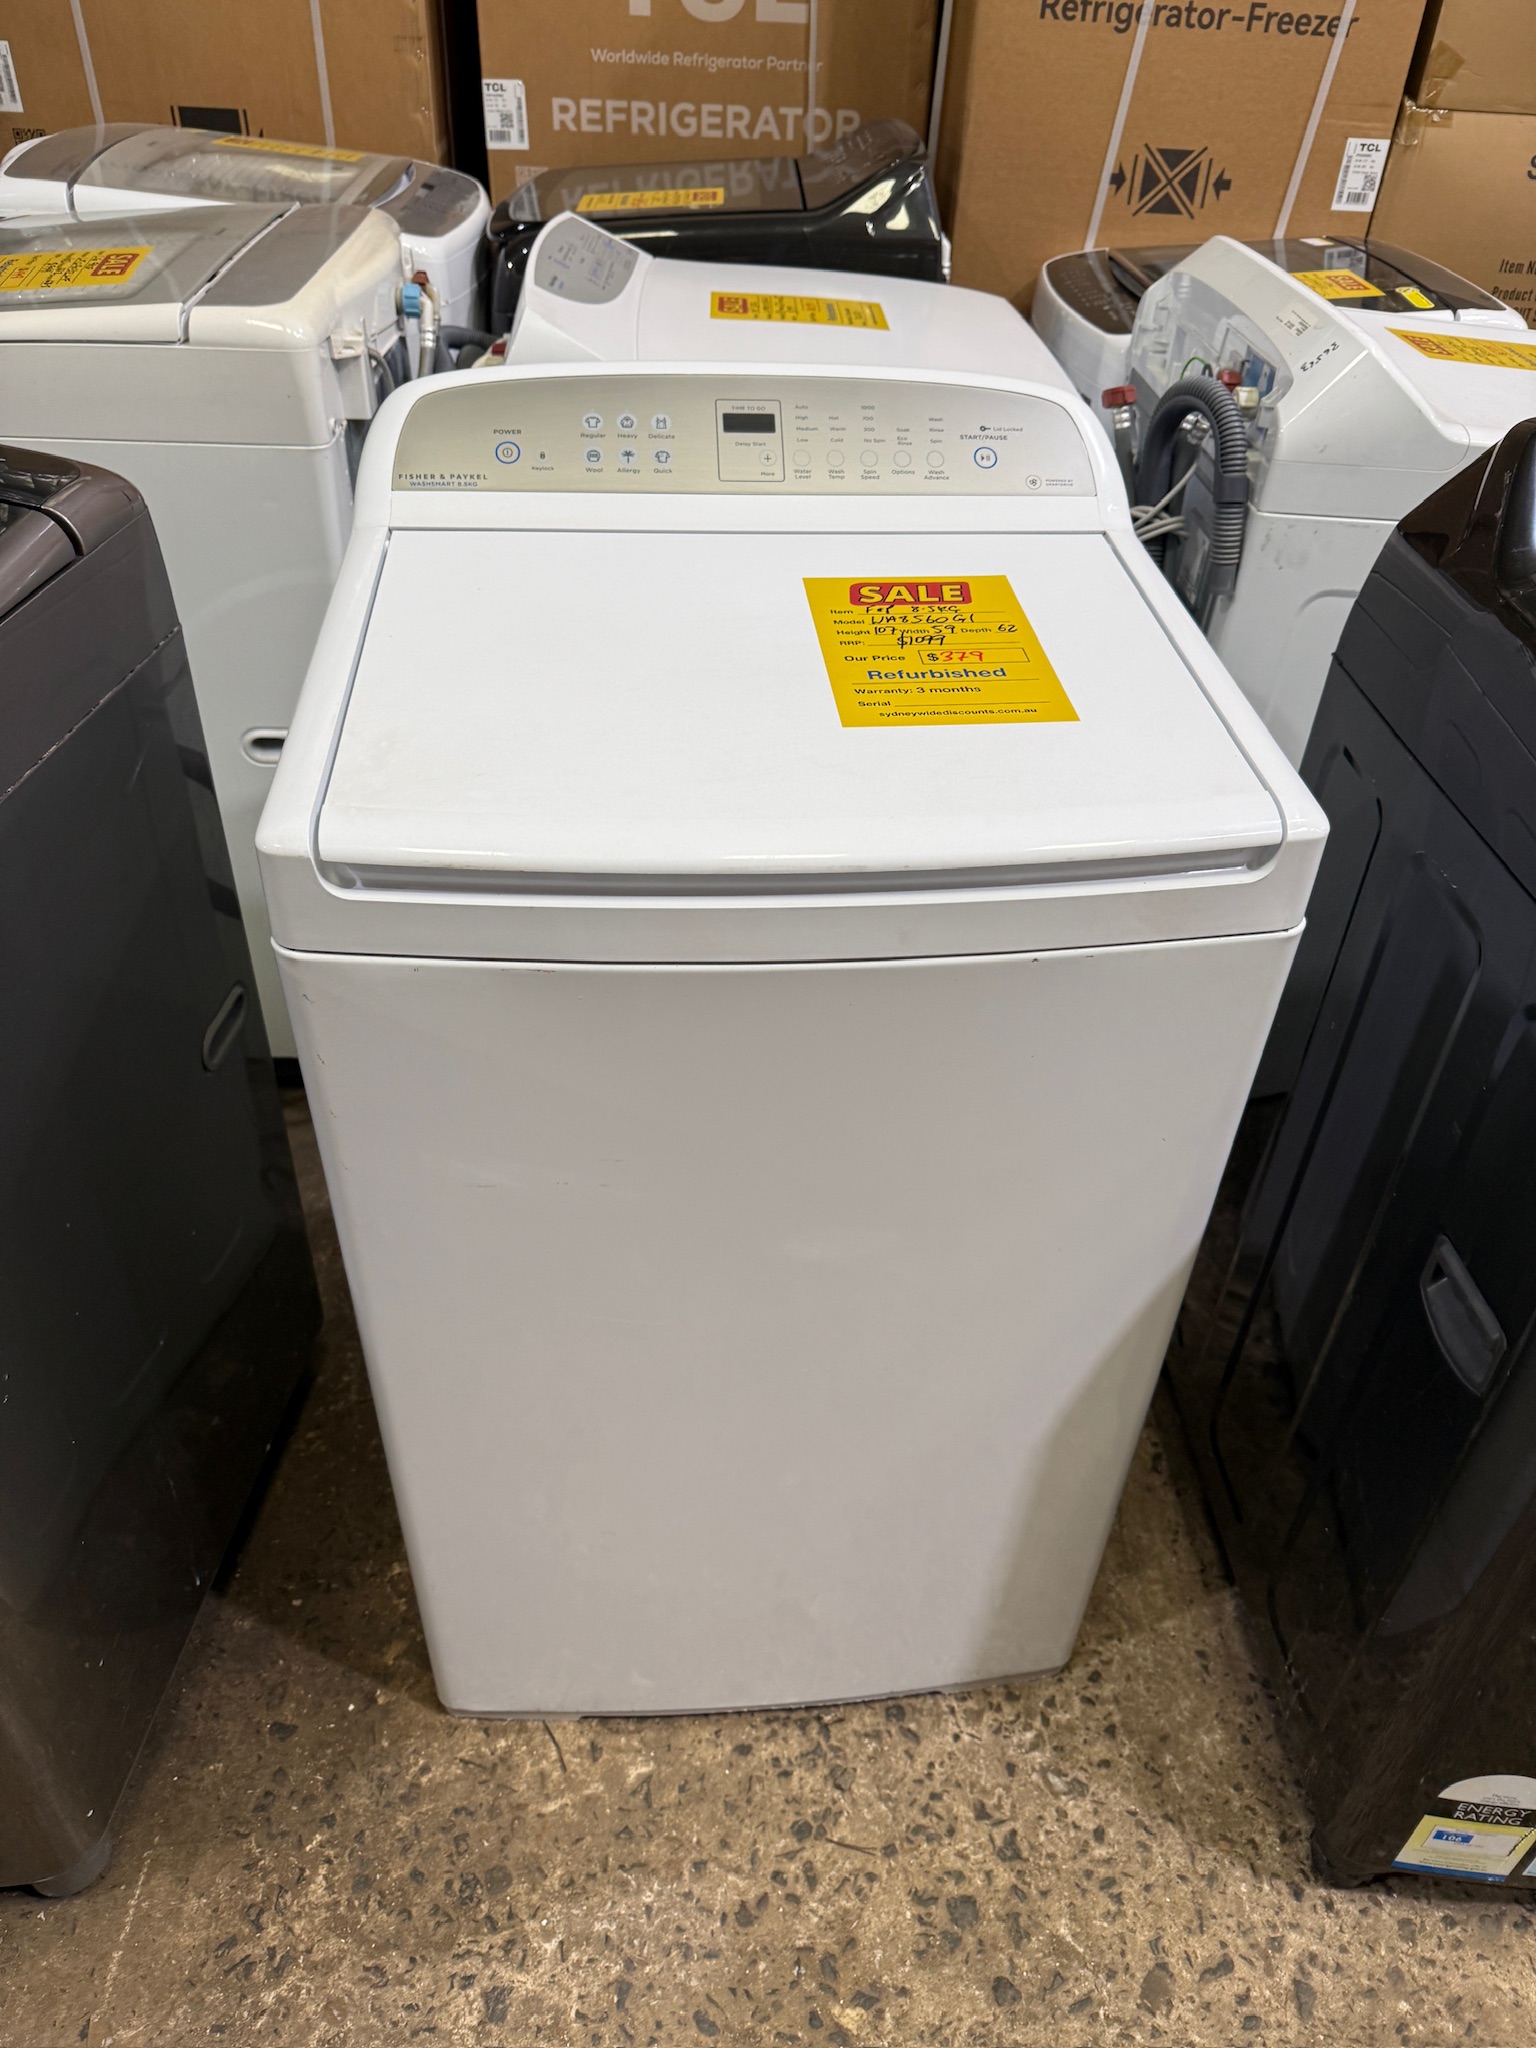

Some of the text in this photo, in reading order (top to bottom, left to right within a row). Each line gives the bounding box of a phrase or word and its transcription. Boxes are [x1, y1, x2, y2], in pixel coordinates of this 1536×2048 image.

[590, 48, 824, 73] Worldwide Refrigerator Partnr
[484, 83, 507, 92] TCL
[1360, 143, 1381, 152] TCL
[98, 254, 134, 276] SALE
[1499, 258, 1524, 274] Item
[858, 584, 964, 604] SALE
[874, 625, 897, 634] 107
[931, 624, 956, 634] 59
[997, 624, 1018, 633] 62
[897, 633, 946, 649] $1099
[872, 654, 905, 662] Price
[926, 650, 984, 662] $379
[867, 667, 1008, 680] Refurbished
[854, 686, 982, 695] Warranty: 3 months
[879, 707, 1038, 718] sydneywidediscounts.com.au
[1456, 1802, 1533, 1818] ENERGY
[1453, 1810, 1523, 1826] RATING
[1442, 1834, 1462, 1842] 106
